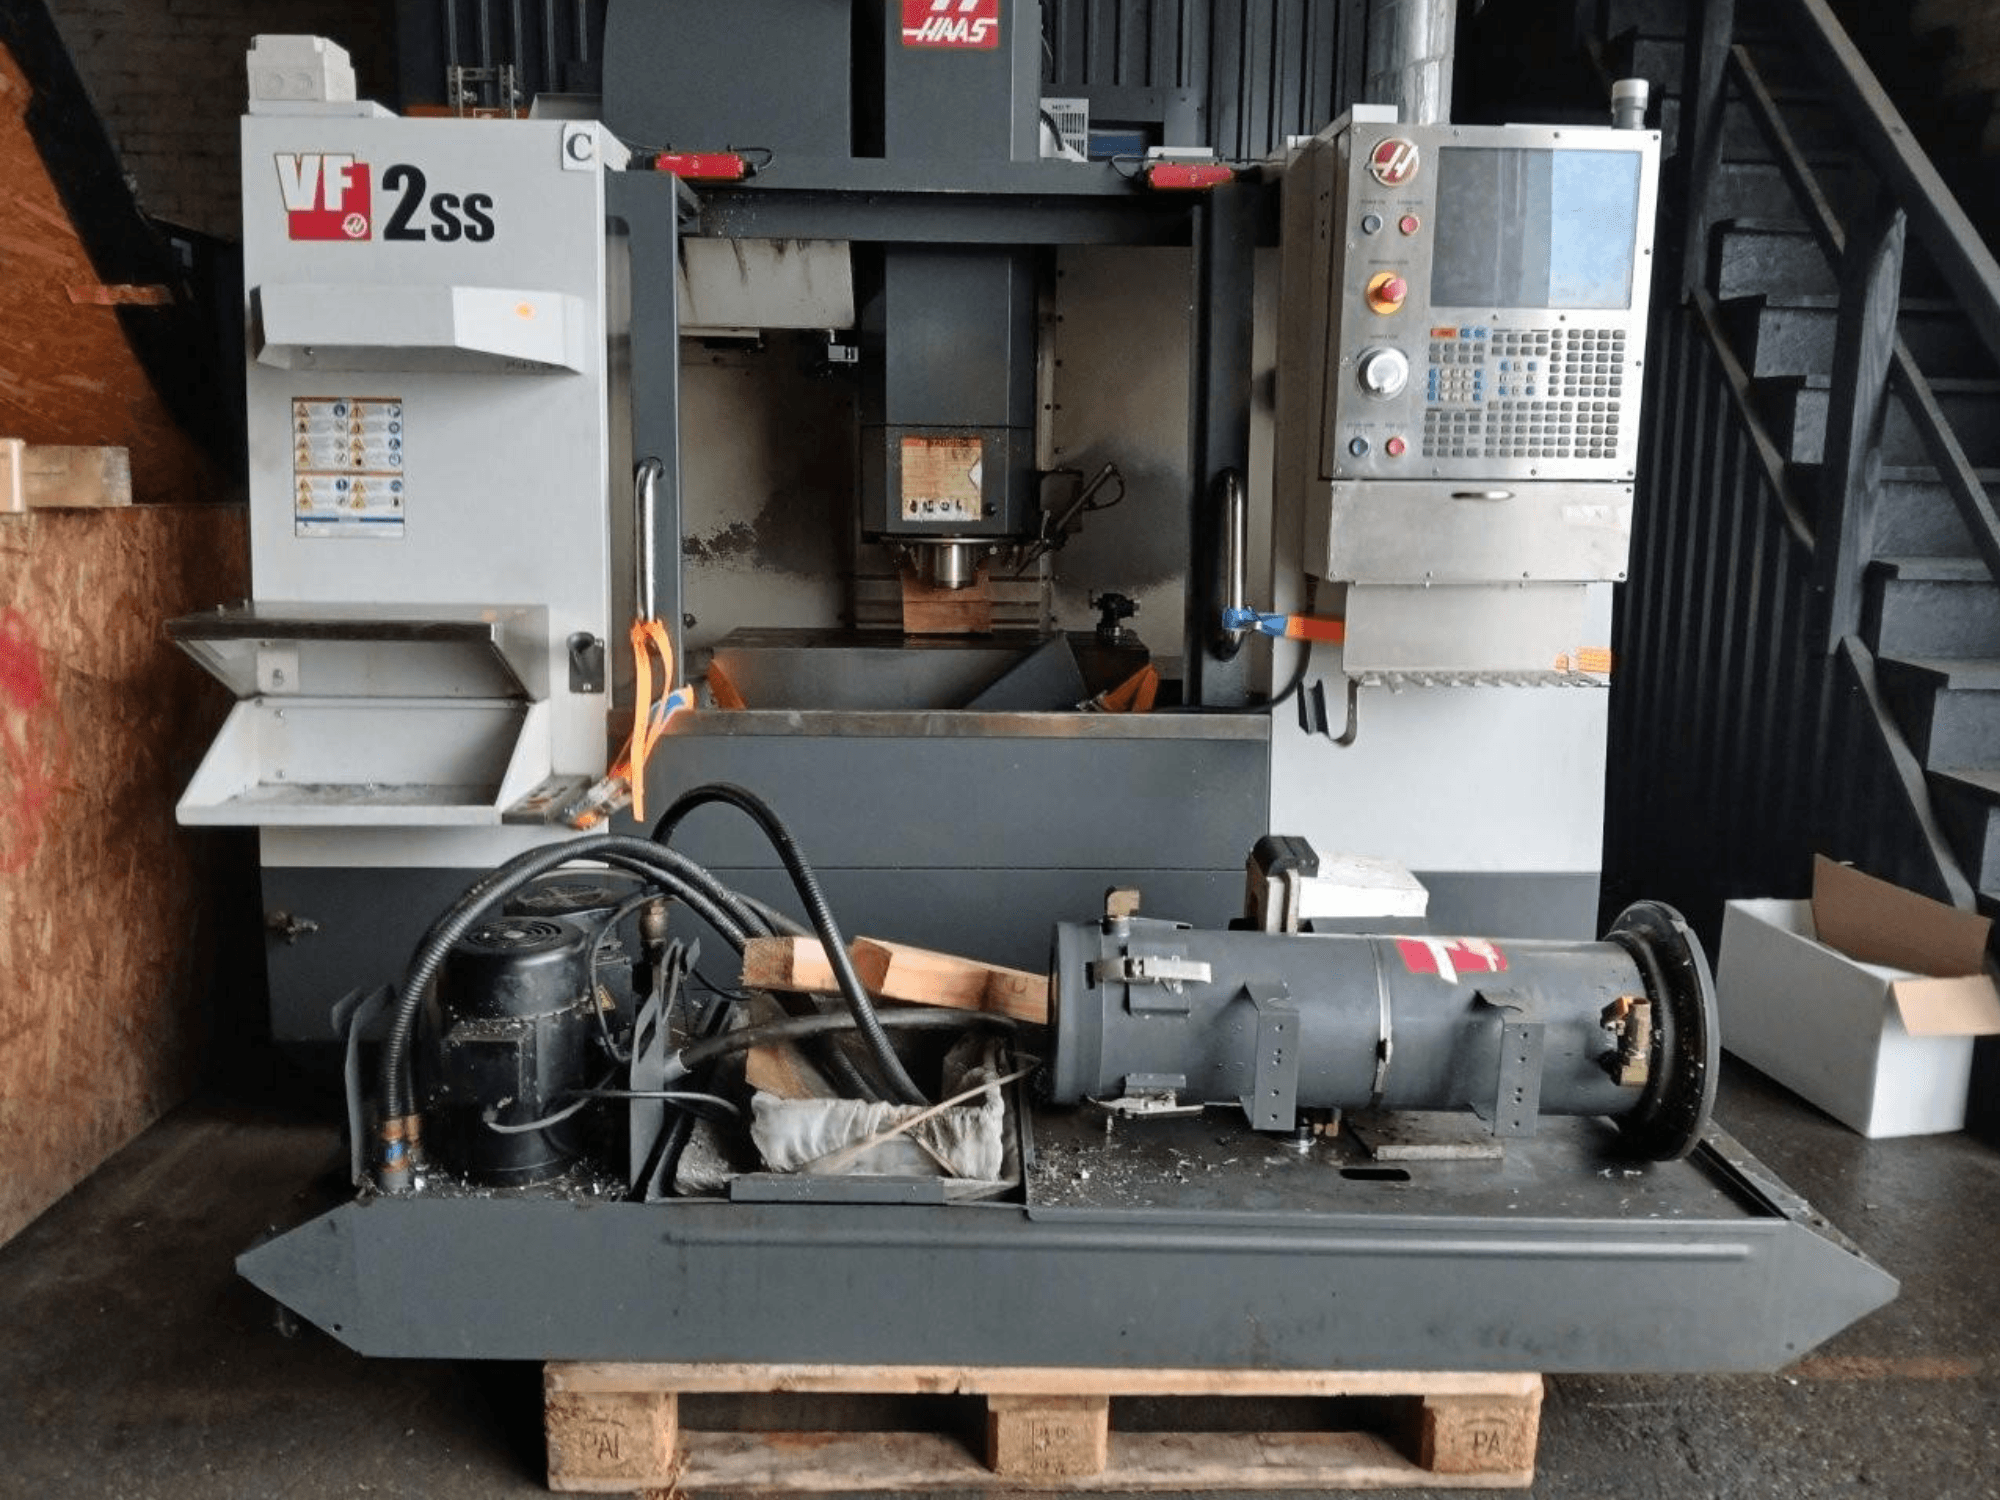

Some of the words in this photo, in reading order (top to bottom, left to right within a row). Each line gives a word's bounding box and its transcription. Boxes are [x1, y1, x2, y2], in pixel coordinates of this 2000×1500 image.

[902, 16, 998, 43] HAAS
[566, 132, 592, 162] C
[274, 153, 355, 212] VF
